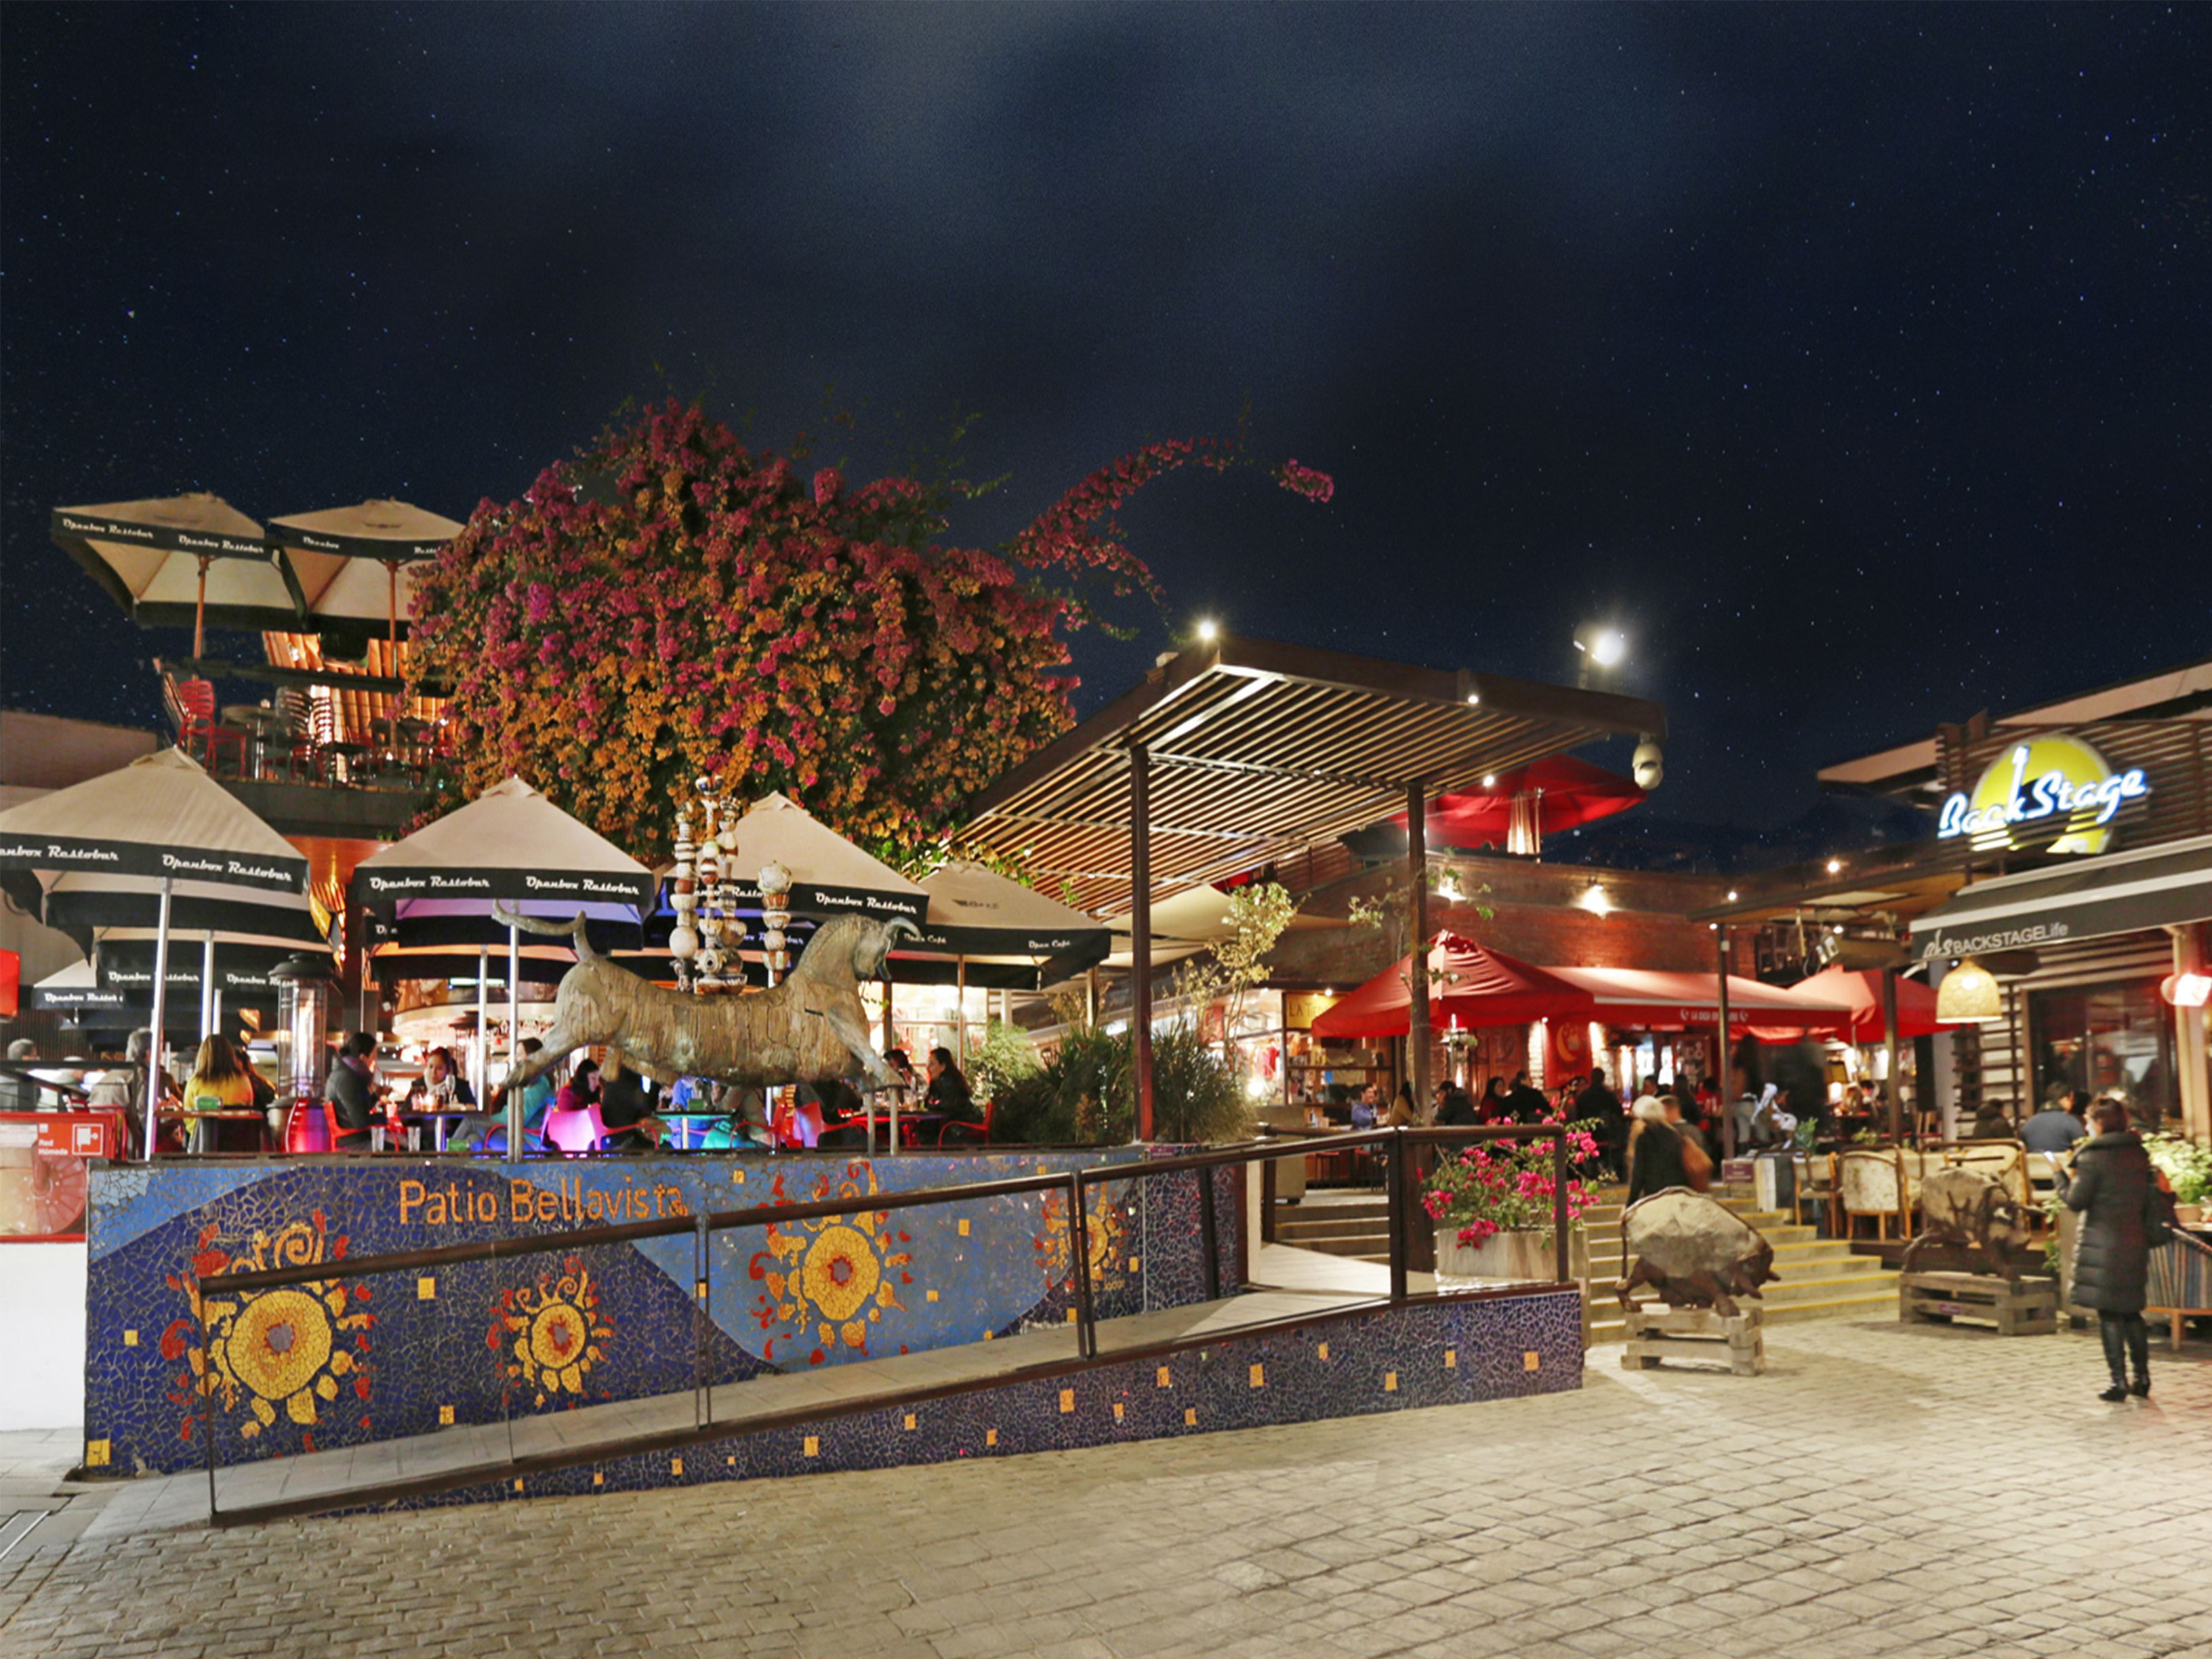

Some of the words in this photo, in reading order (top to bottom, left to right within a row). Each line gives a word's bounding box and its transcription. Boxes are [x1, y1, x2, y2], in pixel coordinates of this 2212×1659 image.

[62, 518, 105, 533] Openbox
[108, 523, 155, 539] Restobar
[178, 534, 219, 548] Openbox
[222, 539, 264, 554] Restobar
[0, 845, 42, 857] enbox
[47, 845, 119, 861] Restobar
[162, 853, 224, 872] Openbox
[228, 861, 292, 882] Restobar
[369, 876, 426, 891] Openbox
[430, 875, 490, 887] Restobar
[525, 876, 579, 890] Openbox
[582, 878, 640, 895] Restobar
[815, 892, 863, 906] Openbox
[866, 896, 917, 915] Restobar
[108, 970, 151, 983] Openbox
[226, 973, 266, 985] Openbox
[44, 992, 84, 1004] Openbox
[398, 1179, 499, 1225] Patio
[510, 1174, 689, 1223] Bellavista
